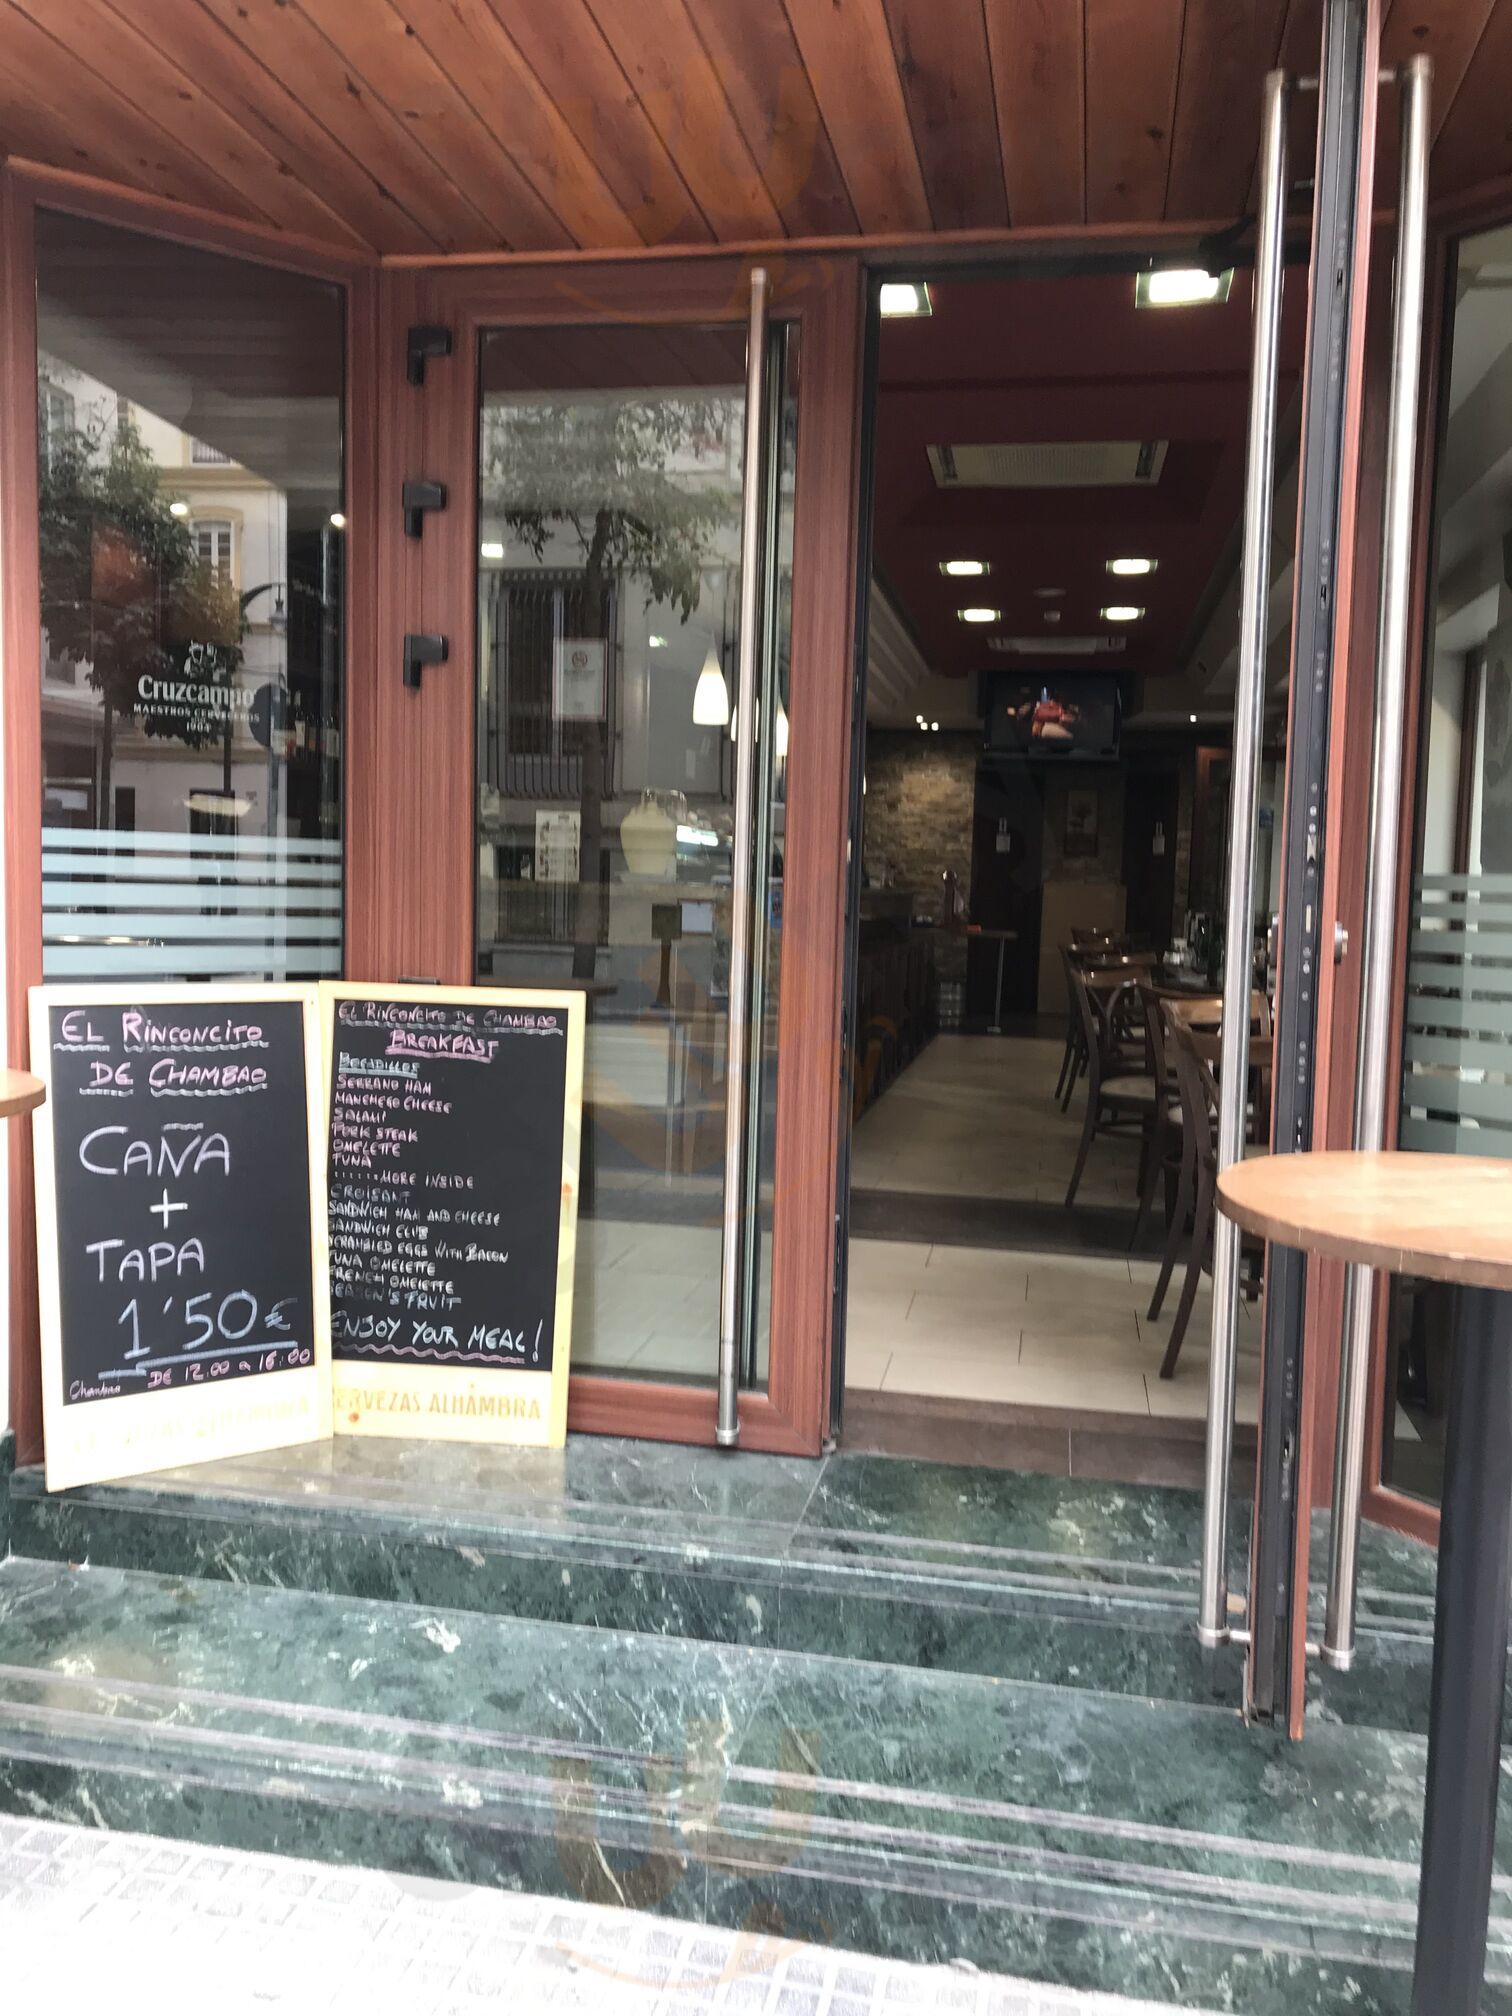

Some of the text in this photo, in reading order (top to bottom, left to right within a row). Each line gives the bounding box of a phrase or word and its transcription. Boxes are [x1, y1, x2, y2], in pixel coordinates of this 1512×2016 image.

[138, 674, 255, 710] Cruzcampo
[133, 703, 191, 718] MAESTROS
[62, 1011, 104, 1043] EL
[389, 1029, 499, 1058] BREAKFAST
[89, 1058, 267, 1088] DE CHAMBAO
[336, 1074, 432, 1095] SERRANO HAM
[335, 1091, 453, 1114] MANCHEGO CHEESE
[333, 1107, 387, 1123] SALAMI
[332, 1121, 418, 1142] PORK STEAK
[333, 1138, 401, 1157] OMELETTE
[332, 1153, 372, 1168] TUNA
[328, 1198, 388, 1220] SANDWICH
[427, 1209, 451, 1223] AND
[455, 1210, 501, 1227] CHEESE
[86, 1237, 205, 1282] TAPA
[397, 1243, 428, 1260] EGGS
[465, 1243, 509, 1264] BACON
[369, 1256, 436, 1276] OMELETTE
[389, 1275, 455, 1295] OMELETTE
[404, 1291, 462, 1311] FRUIT
[331, 1309, 401, 1340] ENJOY
[411, 1320, 459, 1348] YOUR
[333, 1387, 421, 1413] ERVEZAS
